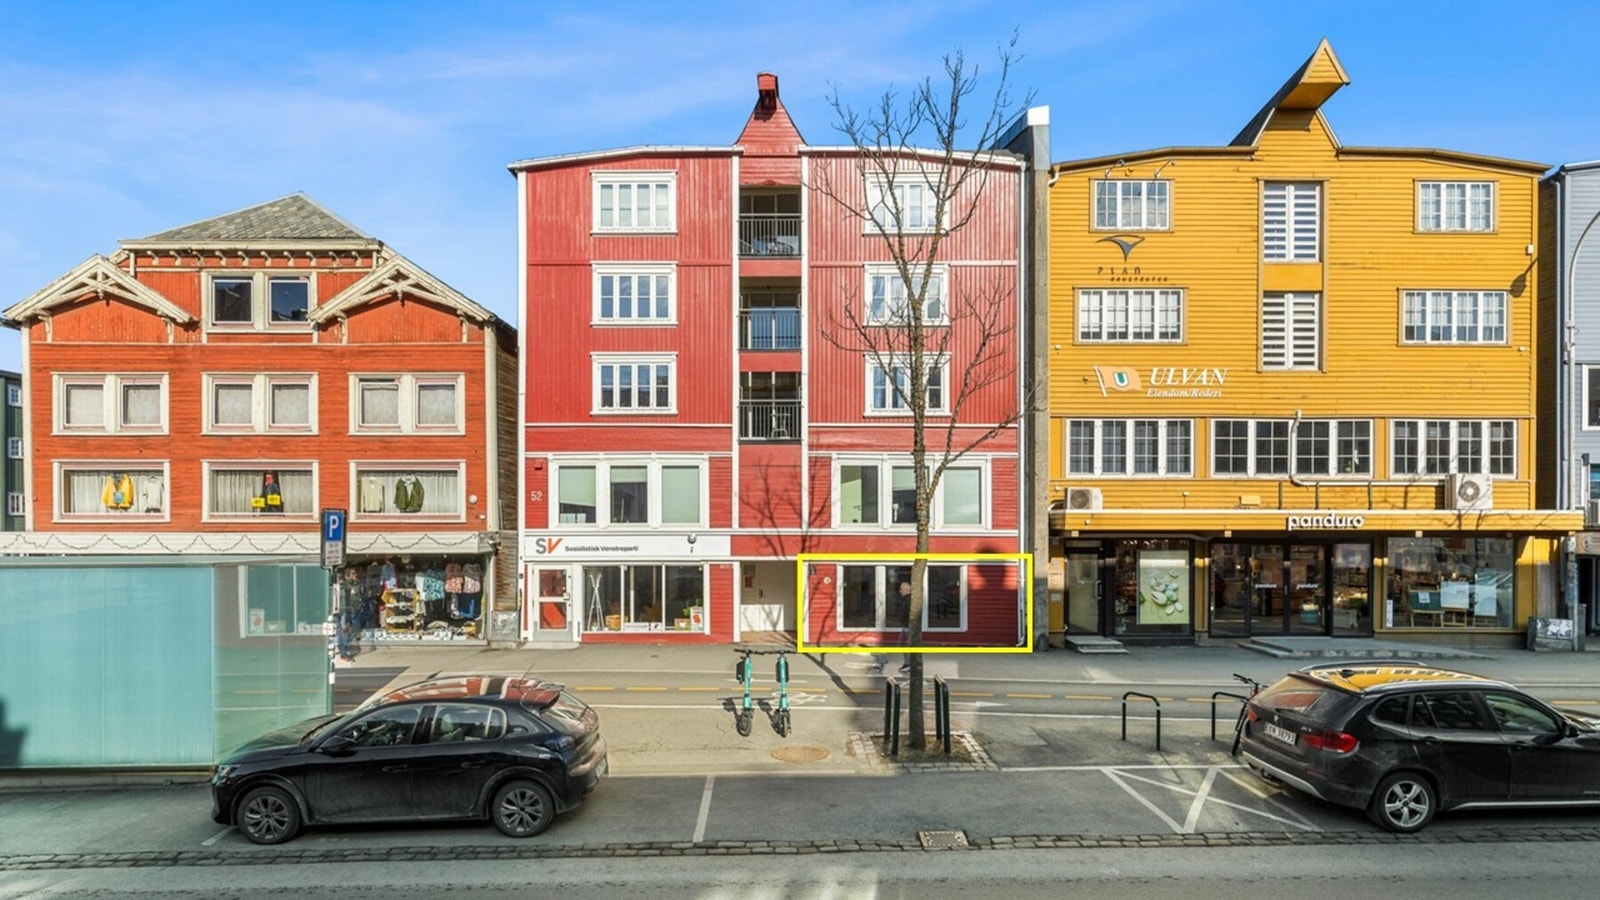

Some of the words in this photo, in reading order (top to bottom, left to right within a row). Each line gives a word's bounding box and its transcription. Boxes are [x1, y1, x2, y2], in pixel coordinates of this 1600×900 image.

[1113, 372, 1129, 387] U
[1149, 367, 1228, 386] ULVAN
[530, 490, 543, 501] 52
[329, 515, 340, 538] P
[1288, 512, 1365, 532] panduro
[535, 538, 563, 554] SV
